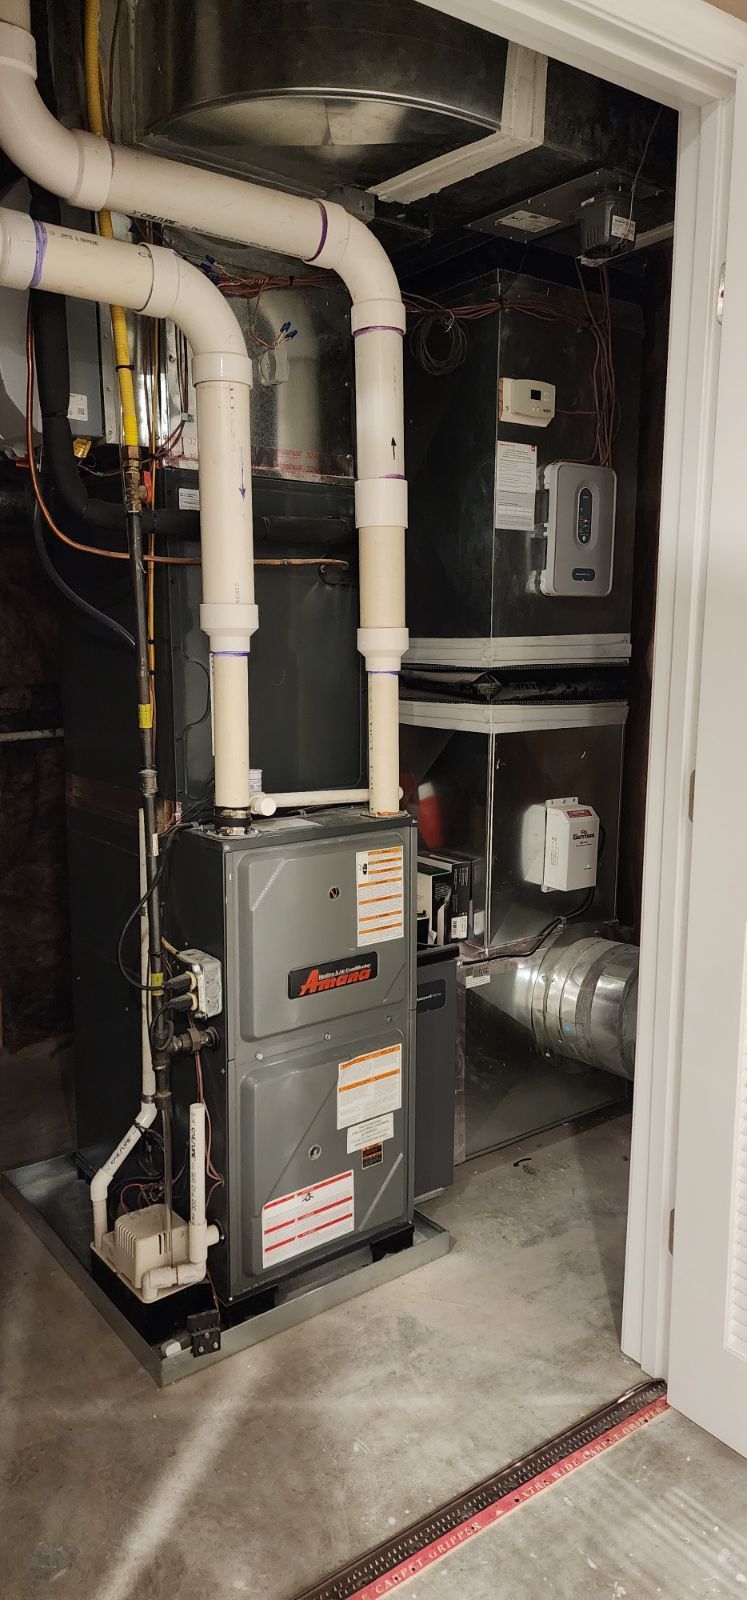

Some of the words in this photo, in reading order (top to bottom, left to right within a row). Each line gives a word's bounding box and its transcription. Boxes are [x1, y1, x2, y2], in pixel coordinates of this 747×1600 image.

[298, 968, 371, 996] Amana
[551, 1458, 582, 1481] WIDE
[622, 1406, 663, 1435] GRIPPER
[374, 1555, 424, 1595] CARPET
[428, 1521, 482, 1560] GRIPPER
